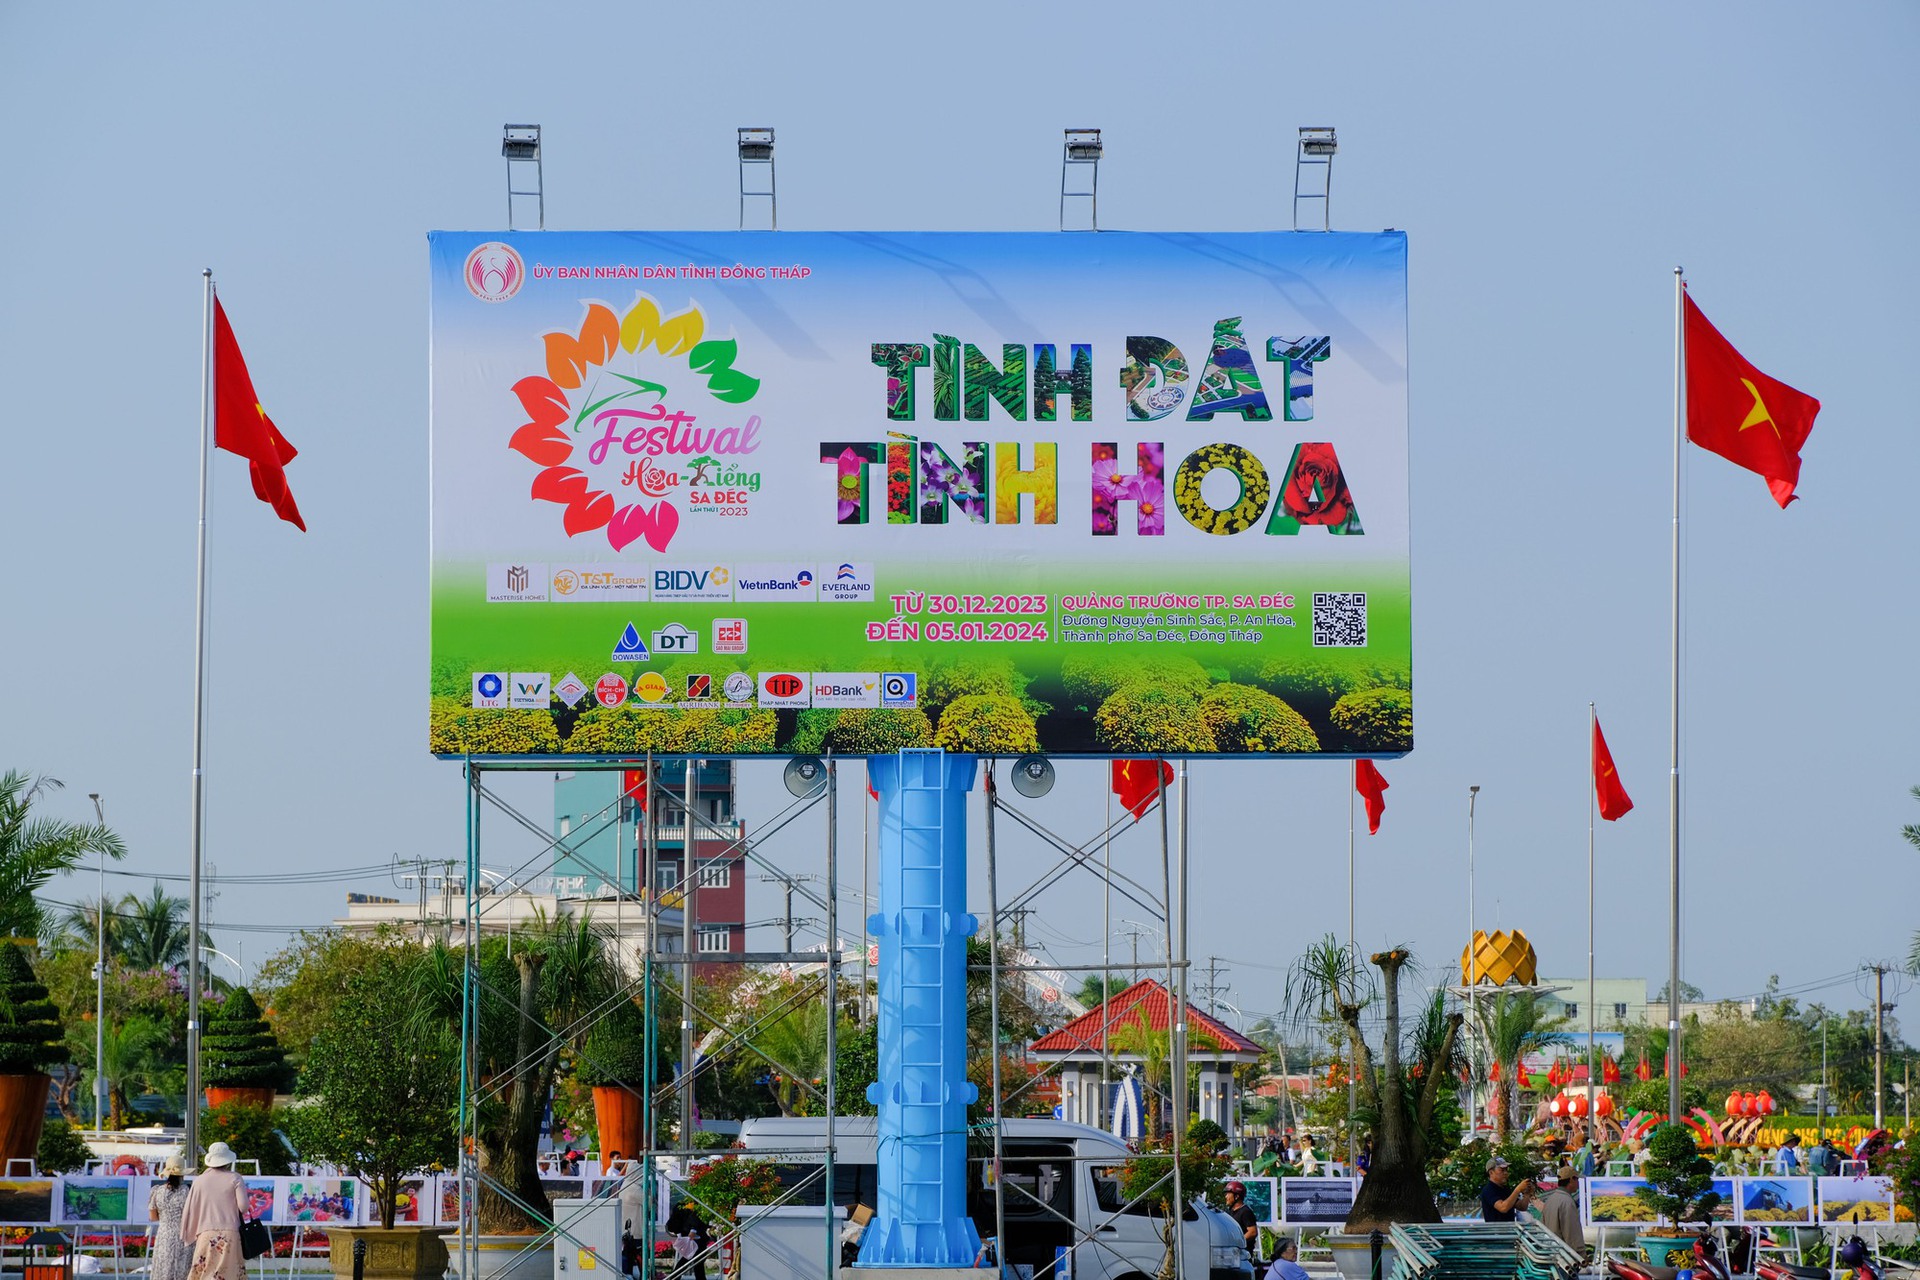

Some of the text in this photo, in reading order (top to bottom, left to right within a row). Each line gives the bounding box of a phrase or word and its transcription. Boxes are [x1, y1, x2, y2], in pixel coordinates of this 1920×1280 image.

[534, 262, 811, 279] ỦY BAN NHÂN DÂN TỈNH ĐỒNG THÁP
[871, 316, 1331, 421] TÌNH ĐẤT
[588, 403, 761, 465] Festival
[820, 430, 1365, 536] TÌNH HOA
[690, 491, 711, 504] SA
[720, 507, 748, 516] 2023
[655, 570, 710, 590] BIDV
[739, 580, 798, 590] VietinBank
[891, 591, 1047, 613] TỪ 30.12.2023
[1062, 592, 1295, 610] QUẢNG TRƯỜNG TP. SA ĐÉC
[866, 616, 1047, 640] ĐẾN 05.01.2024
[1062, 613, 1296, 628] Đường Nguyễn Sinh Sắc, P. An Hòa,
[661, 635, 688, 649] DT
[1062, 628, 1263, 643] Thành phố Sa Đéc, Đồng Tháp
[815, 685, 862, 696] HDBank
